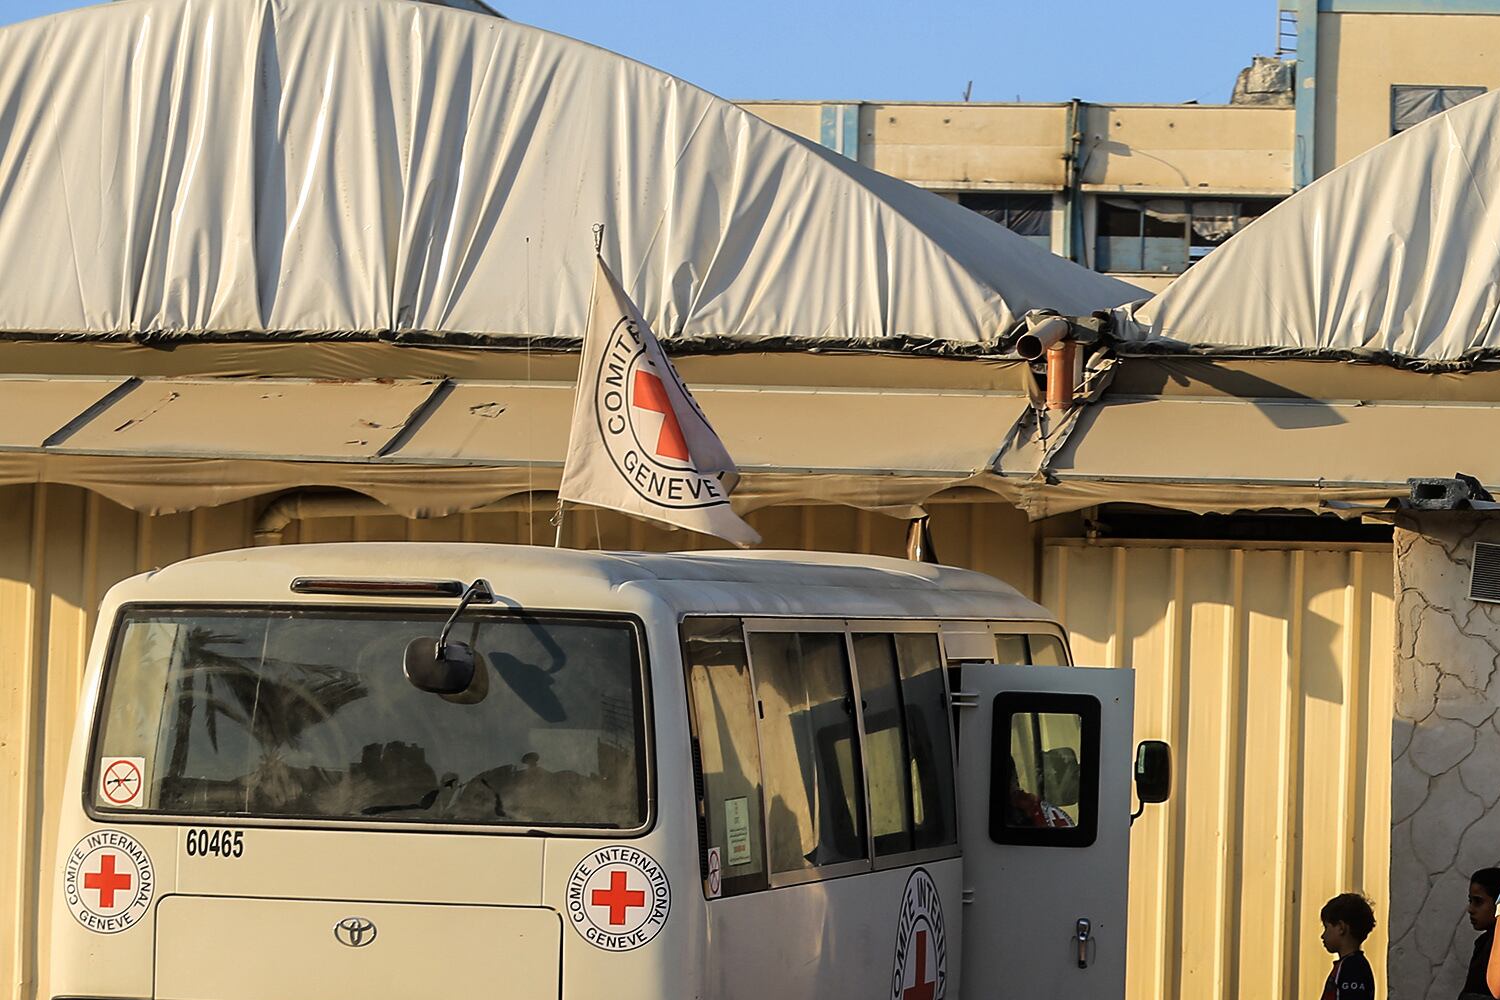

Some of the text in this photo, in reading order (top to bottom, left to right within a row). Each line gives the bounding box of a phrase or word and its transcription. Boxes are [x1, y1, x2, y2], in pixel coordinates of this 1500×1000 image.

[623, 450, 721, 500] GENEVE
[186, 829, 244, 858] 60465
[67, 833, 151, 908] COMITE INTERNATIONAL
[570, 849, 668, 925] COMITE INTERNATIONAL
[79, 910, 134, 931] GENEVE
[586, 927, 648, 949] GENEVE
